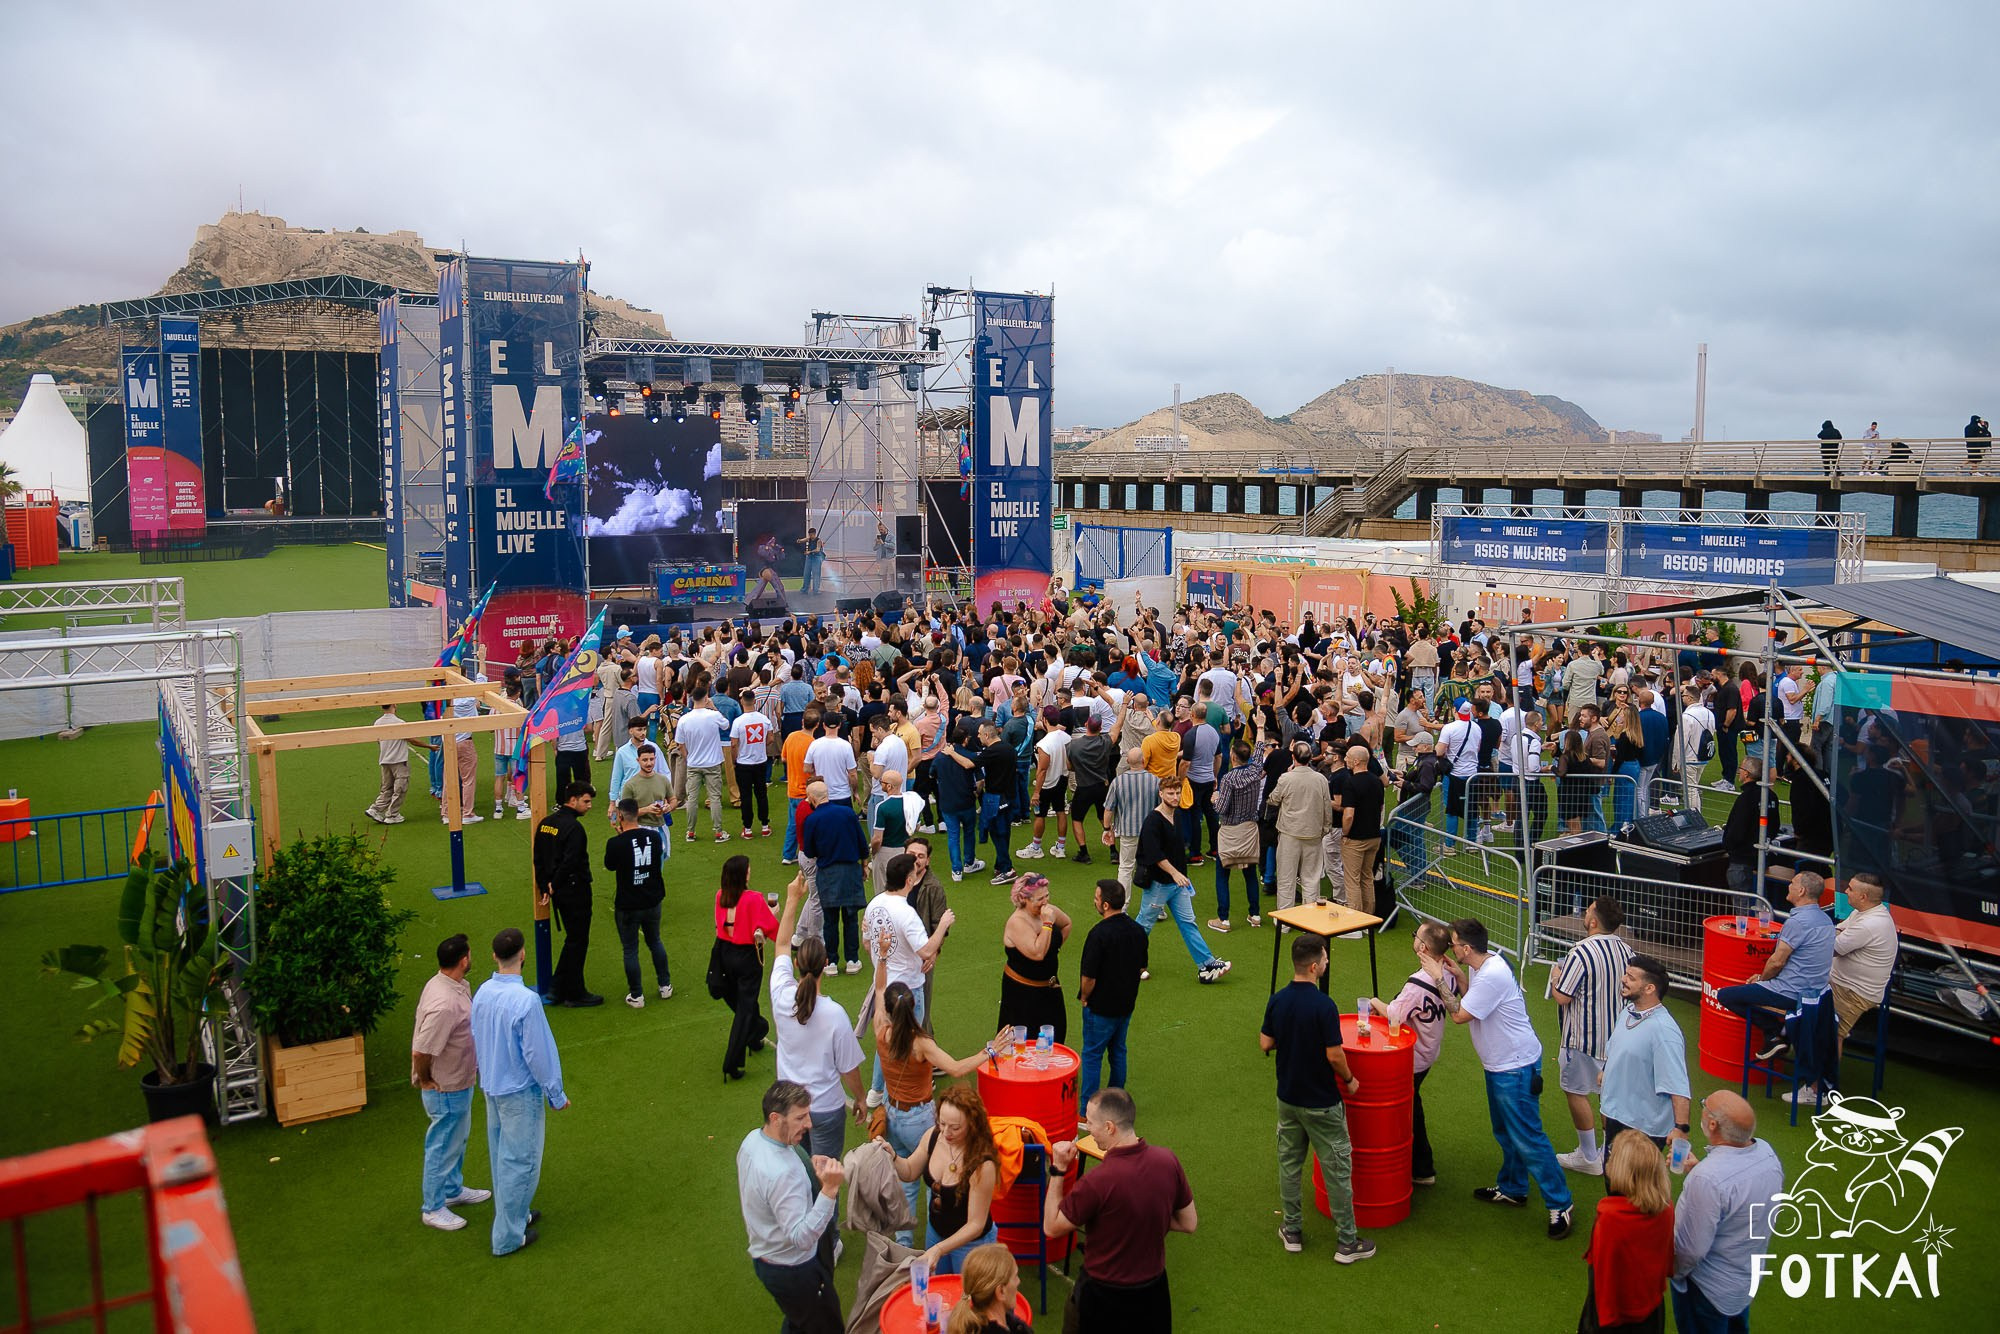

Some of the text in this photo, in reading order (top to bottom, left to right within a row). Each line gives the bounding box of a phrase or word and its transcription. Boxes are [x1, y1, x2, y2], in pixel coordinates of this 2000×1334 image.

[483, 291, 564, 304] ELMUELLELIVE.COM
[986, 317, 1042, 329] ELMUELLELIVE.COM
[171, 354, 190, 397] UELLE
[128, 378, 158, 408] M
[131, 421, 160, 430] MUELLE
[132, 429, 147, 438] LIVE
[491, 384, 563, 469] M
[990, 395, 1040, 467] M
[443, 362, 457, 515] MUELLE
[382, 391, 394, 520] MUELLE
[495, 488, 517, 508] EL
[990, 482, 1006, 498] EL
[990, 501, 1040, 518] MUELLE
[496, 510, 566, 531] MUELLE
[990, 520, 1019, 538] LIVE
[1506, 526, 1533, 537] MUELLE
[497, 533, 536, 554] LIVE
[1704, 535, 1739, 547] MUELLE
[1474, 543, 1567, 562] ASEOS MUJERES
[1663, 554, 1785, 576] ASEOS HOMBRES
[674, 573, 733, 588] CARIÑA
[1008, 588, 1031, 597] EPACIO
[505, 614, 561, 625] MÚSICA, ARTE,
[502, 625, 565, 637] GASTRONOMA Y
[634, 845, 652, 867] M
[1981, 900, 1998, 916] UN
